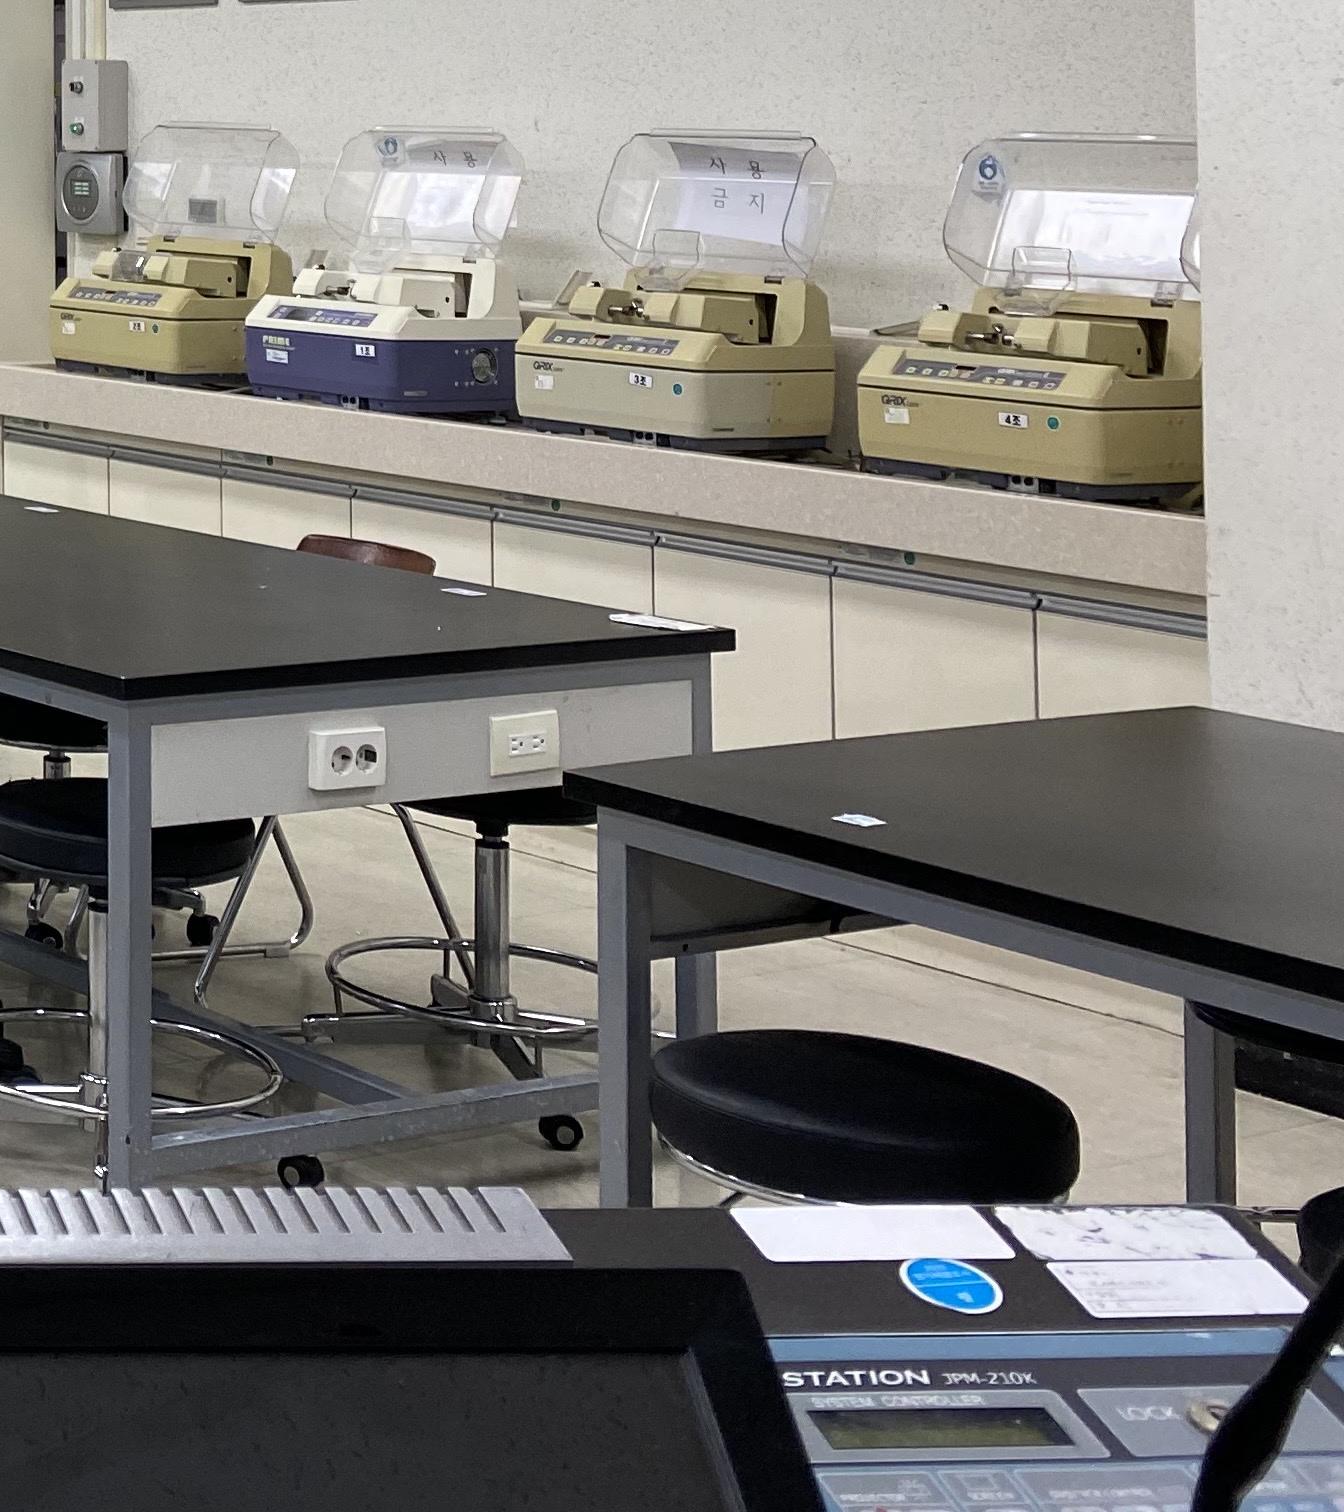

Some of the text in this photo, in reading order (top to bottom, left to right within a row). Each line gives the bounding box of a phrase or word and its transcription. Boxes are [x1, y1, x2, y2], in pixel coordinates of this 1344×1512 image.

[709, 156, 765, 180] 사용
[711, 187, 765, 215] 금지
[633, 373, 648, 387] 3조
[1004, 414, 1022, 427] 4조
[782, 1369, 932, 1388] STATION
